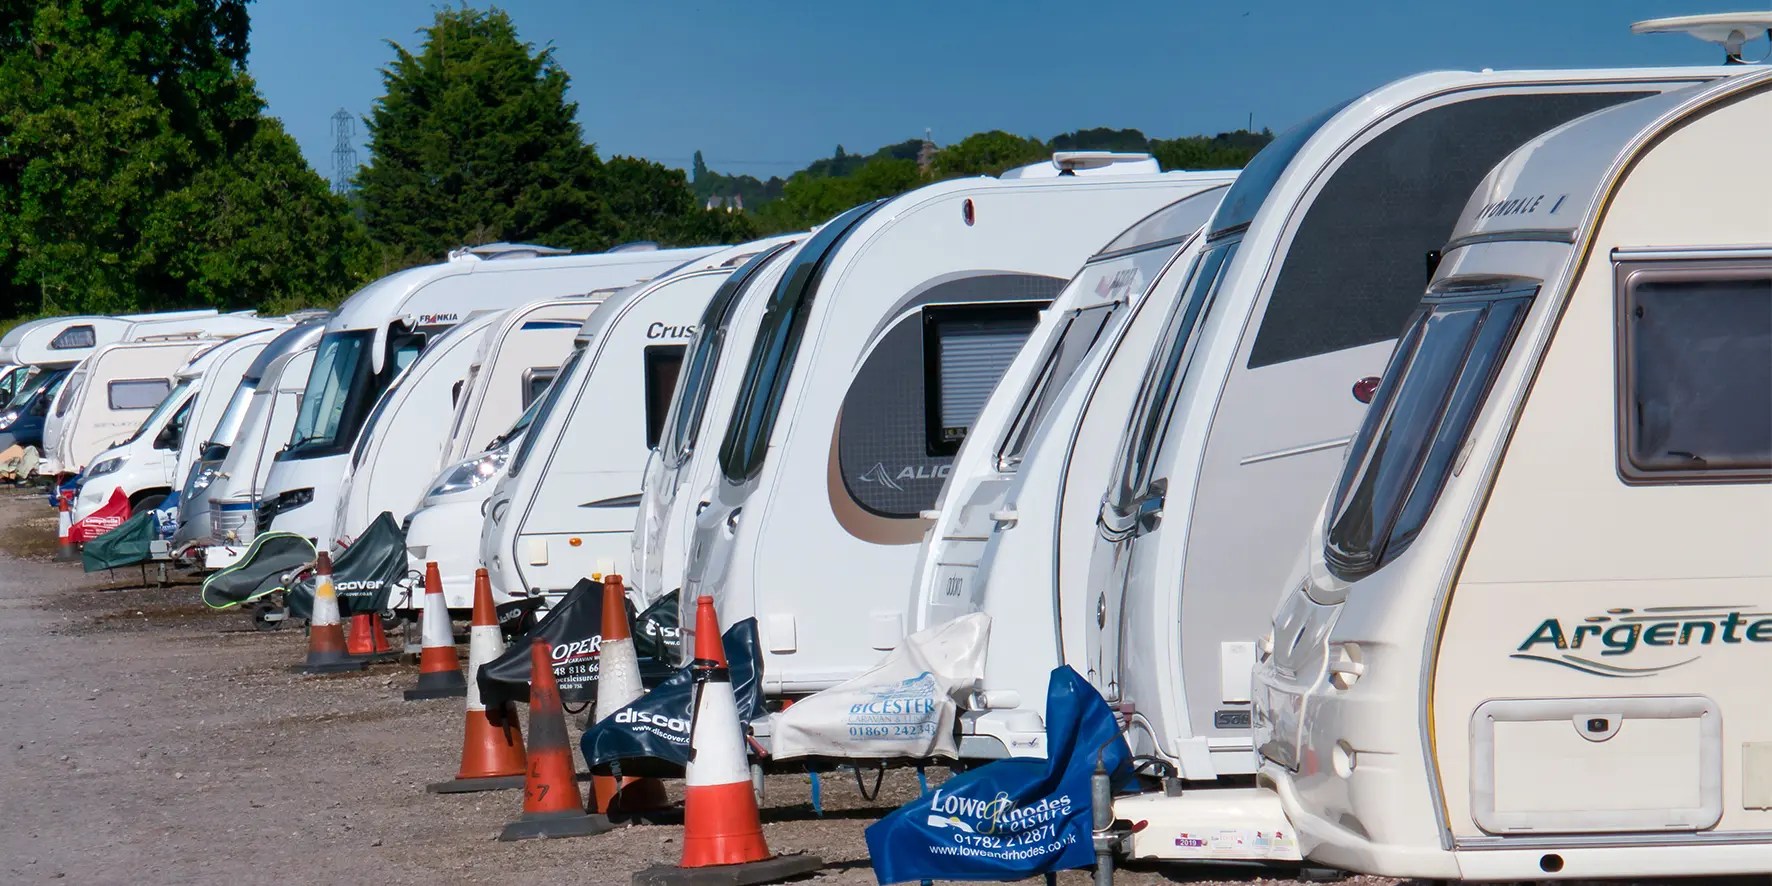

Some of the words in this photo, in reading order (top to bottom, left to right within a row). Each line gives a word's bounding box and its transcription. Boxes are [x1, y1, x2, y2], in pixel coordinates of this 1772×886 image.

[419, 313, 458, 323] FRANKIA
[646, 321, 697, 339] Crus
[896, 464, 952, 480] ALIC
[335, 580, 384, 591] cover
[1517, 611, 1772, 656] Argente
[551, 634, 602, 661] OPER
[553, 667, 566, 676] 48
[568, 664, 586, 674] 818
[588, 663, 600, 673] 66
[849, 698, 936, 715] BICESTER
[631, 724, 691, 744] www.discover.c
[849, 726, 889, 737] 01869
[953, 833, 1002, 849] 01782
[1006, 823, 1056, 848] 212871
[1180, 838, 1197, 847] 2019
